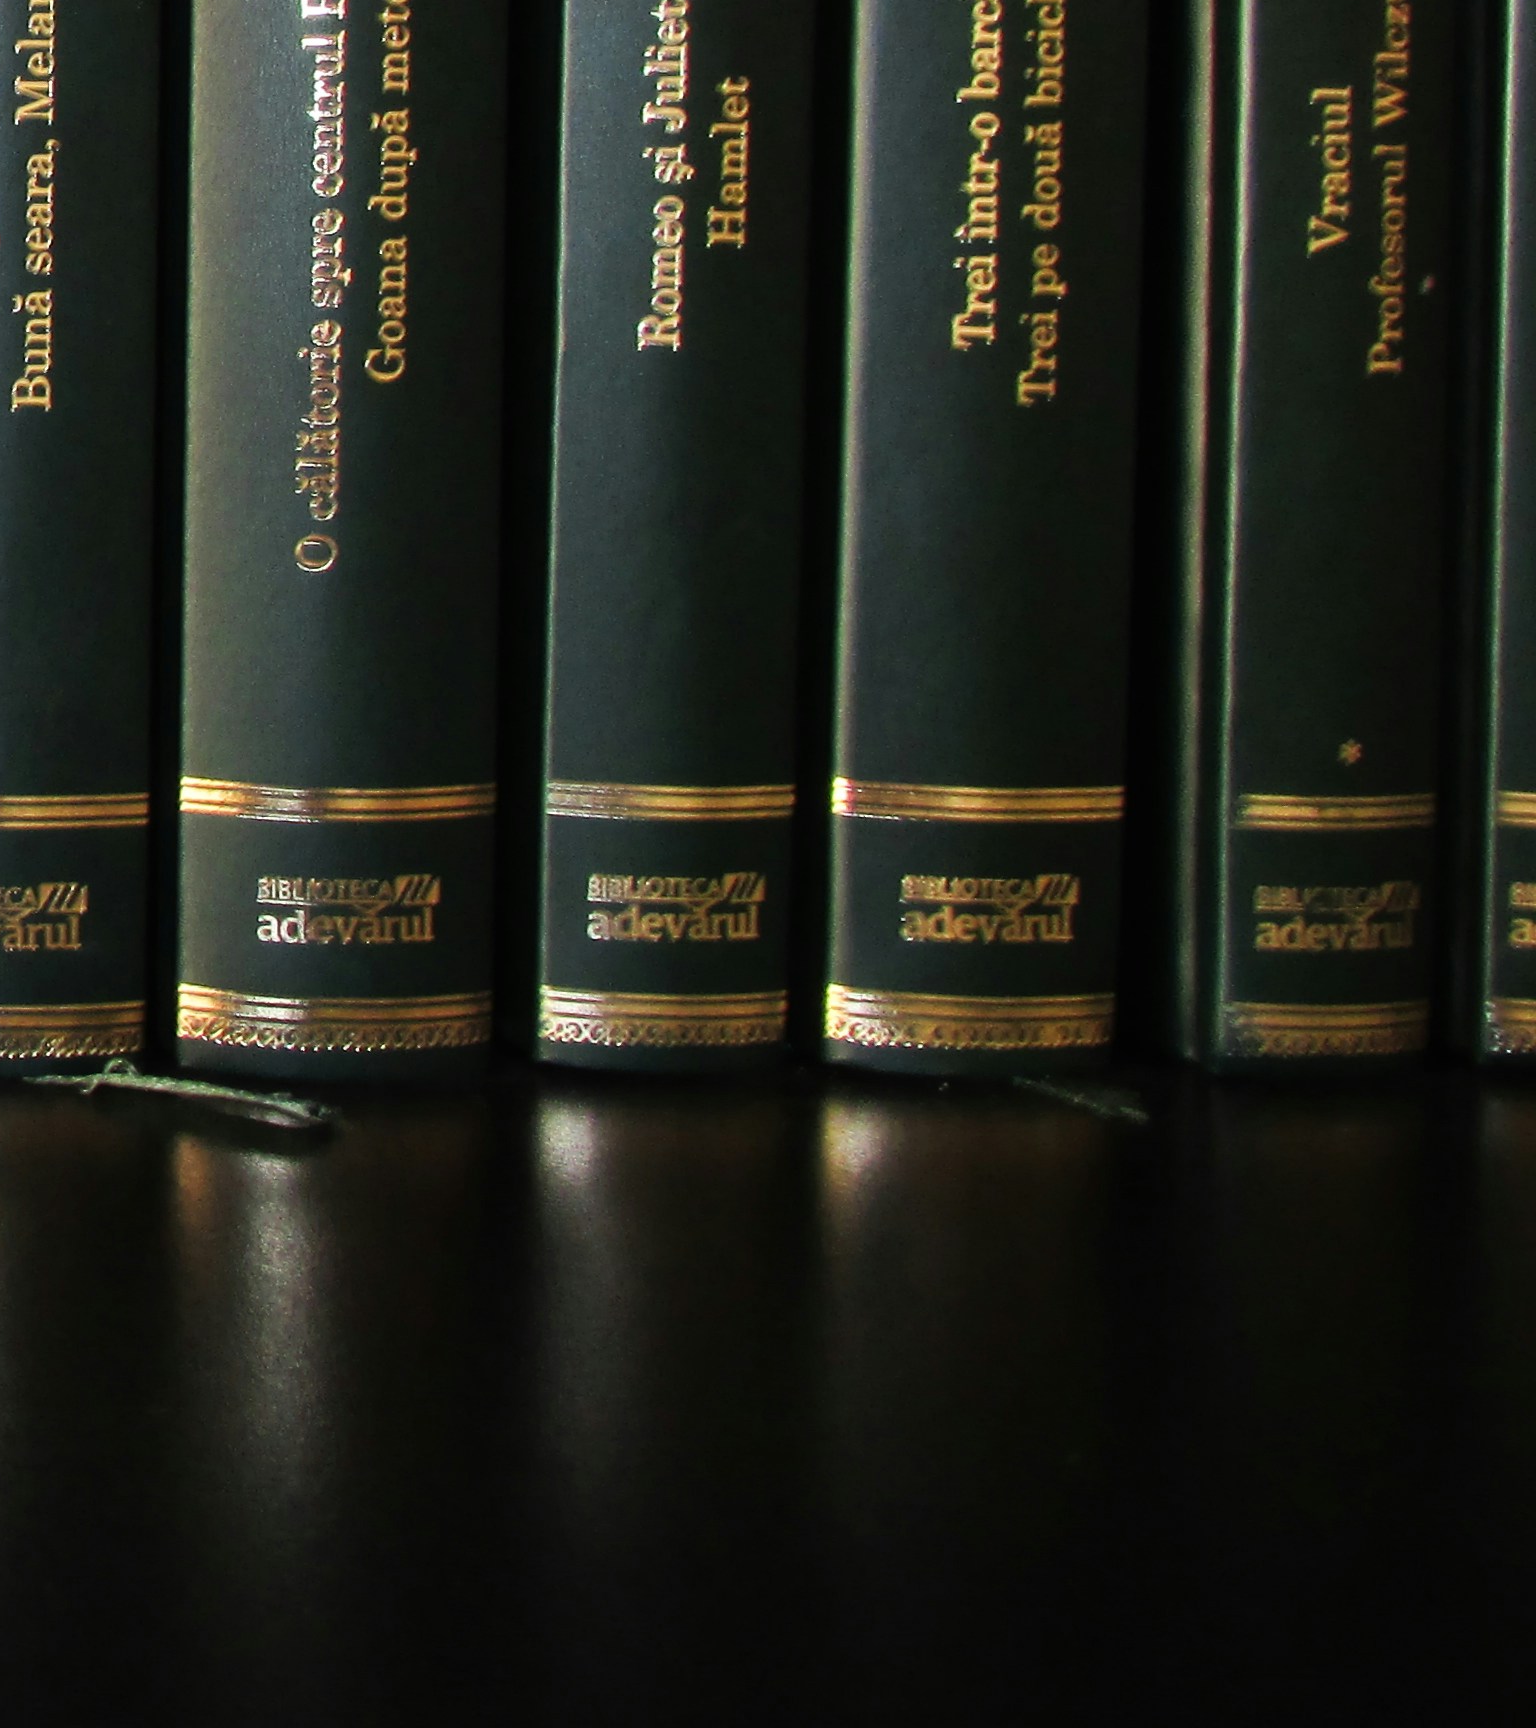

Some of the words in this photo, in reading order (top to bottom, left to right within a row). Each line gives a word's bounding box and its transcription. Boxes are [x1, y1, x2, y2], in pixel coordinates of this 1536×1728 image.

[301, 30, 346, 197] centrul
[367, 108, 418, 220] după
[706, 77, 750, 249] Hamlet
[1021, 121, 1063, 228] două
[1307, 86, 1352, 254] Vraciul
[25, 139, 59, 275] seara,
[311, 208, 352, 308] spre
[1367, 144, 1407, 373] Profesorul
[364, 236, 407, 382] Goana
[637, 196, 684, 352] Romeo
[952, 254, 998, 351] Trei
[1032, 245, 1068, 300] pe
[11, 289, 52, 412] Bună
[1017, 310, 1059, 405] Trei
[295, 534, 338, 572] O
